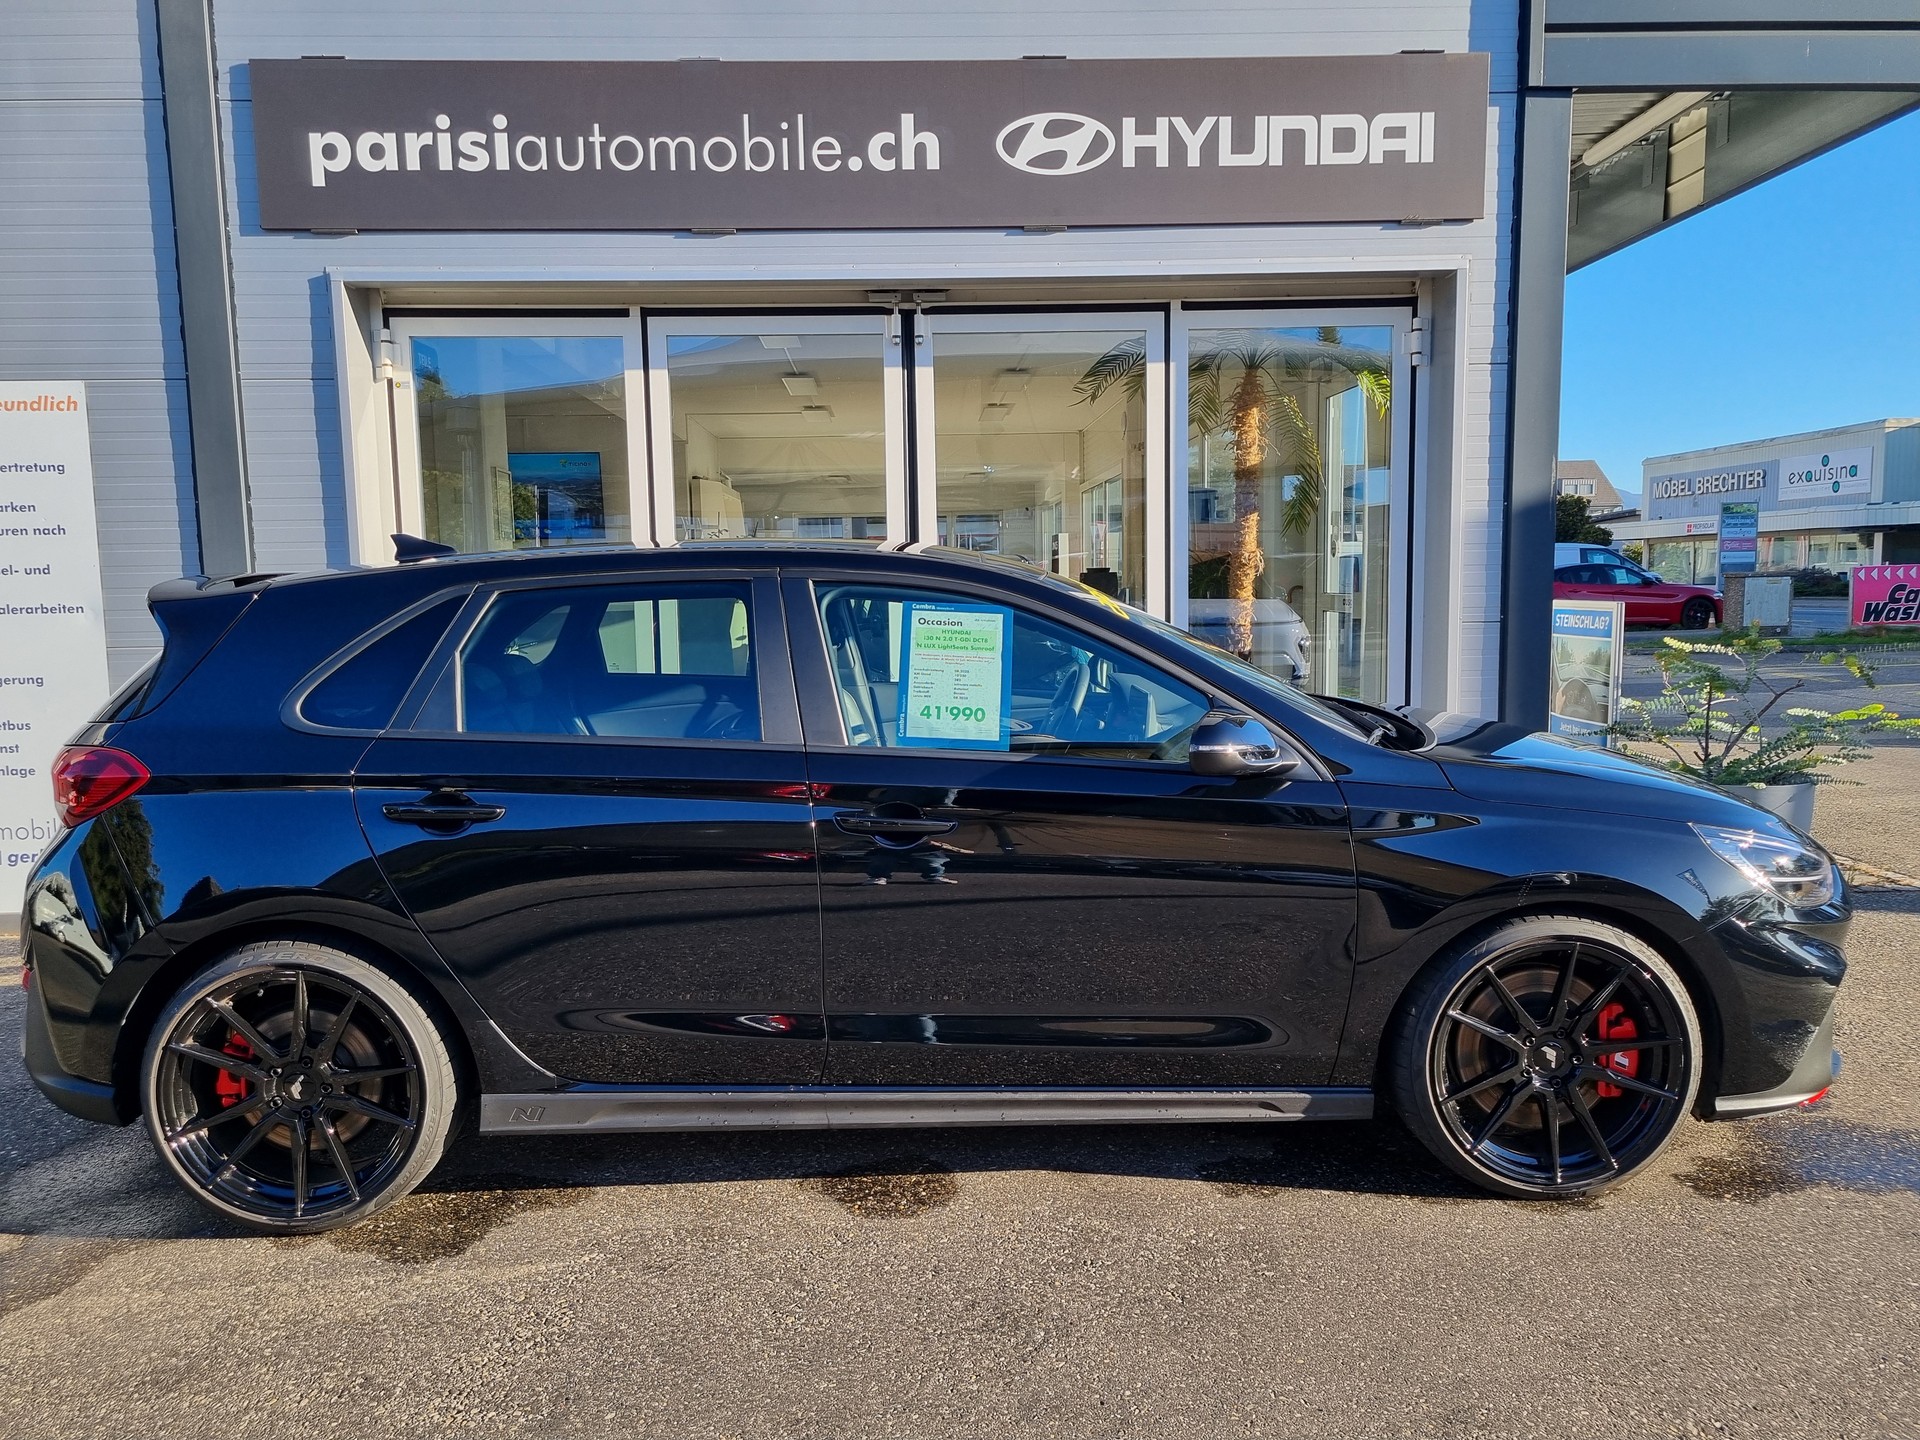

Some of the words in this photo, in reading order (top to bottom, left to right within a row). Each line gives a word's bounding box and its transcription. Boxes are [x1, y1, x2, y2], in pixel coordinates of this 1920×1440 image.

[1122, 112, 1435, 167] HYUNDAI
[308, 113, 940, 187] parisiautomobile.ch
[0, 463, 65, 475] ertretung
[1653, 477, 1692, 499] MÖBEL
[1696, 469, 1764, 494] BRECHTER
[33, 525, 66, 535] nach
[24, 564, 50, 575] und
[918, 617, 963, 627] Occasion
[1555, 614, 1610, 630] STEINSCHLAG?
[0, 677, 44, 687] erung
[919, 705, 986, 723] 41'990
[0, 720, 31, 731] tbus
[7, 848, 44, 867] ger
